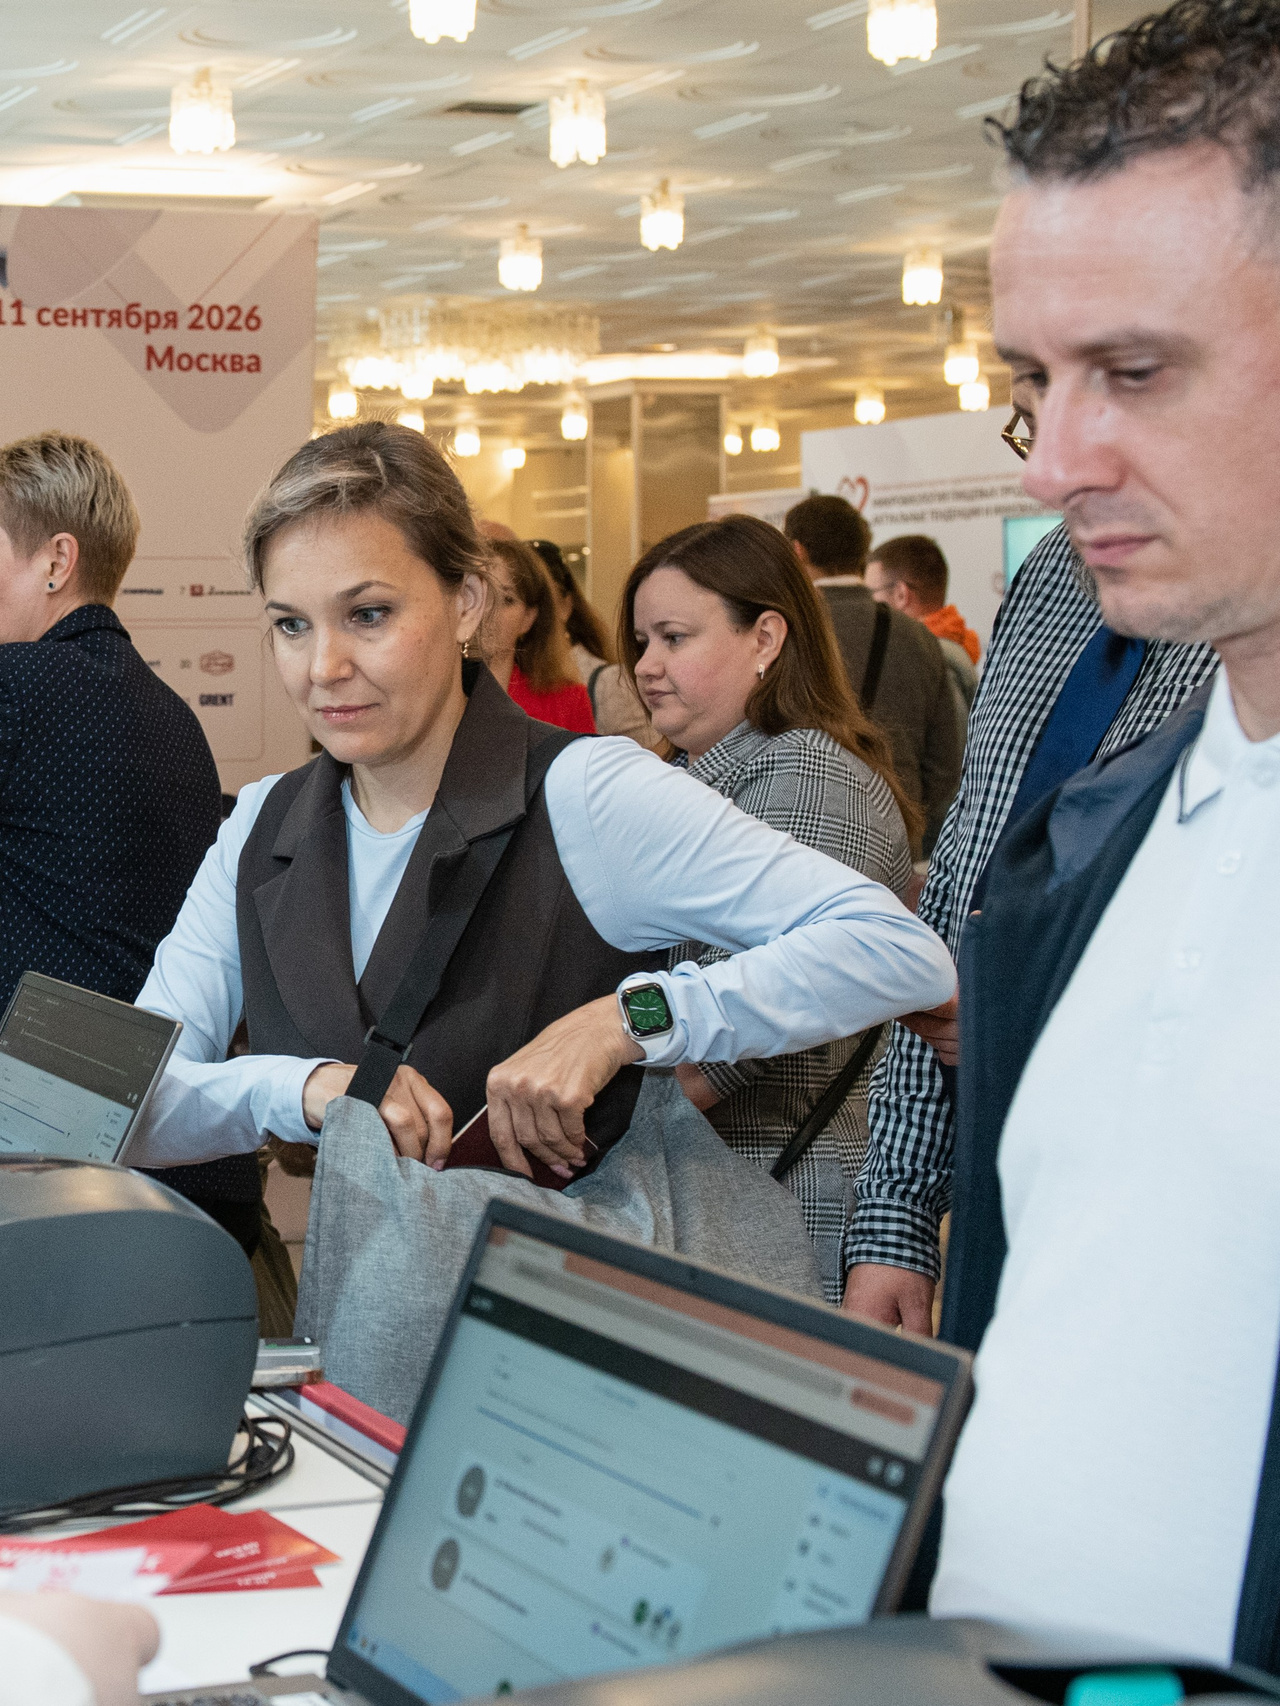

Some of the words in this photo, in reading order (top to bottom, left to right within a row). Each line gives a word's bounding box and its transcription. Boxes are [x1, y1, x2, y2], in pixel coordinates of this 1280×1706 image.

[36, 302, 179, 334] сентября
[187, 303, 262, 332] 2026
[145, 345, 262, 374] Москва
